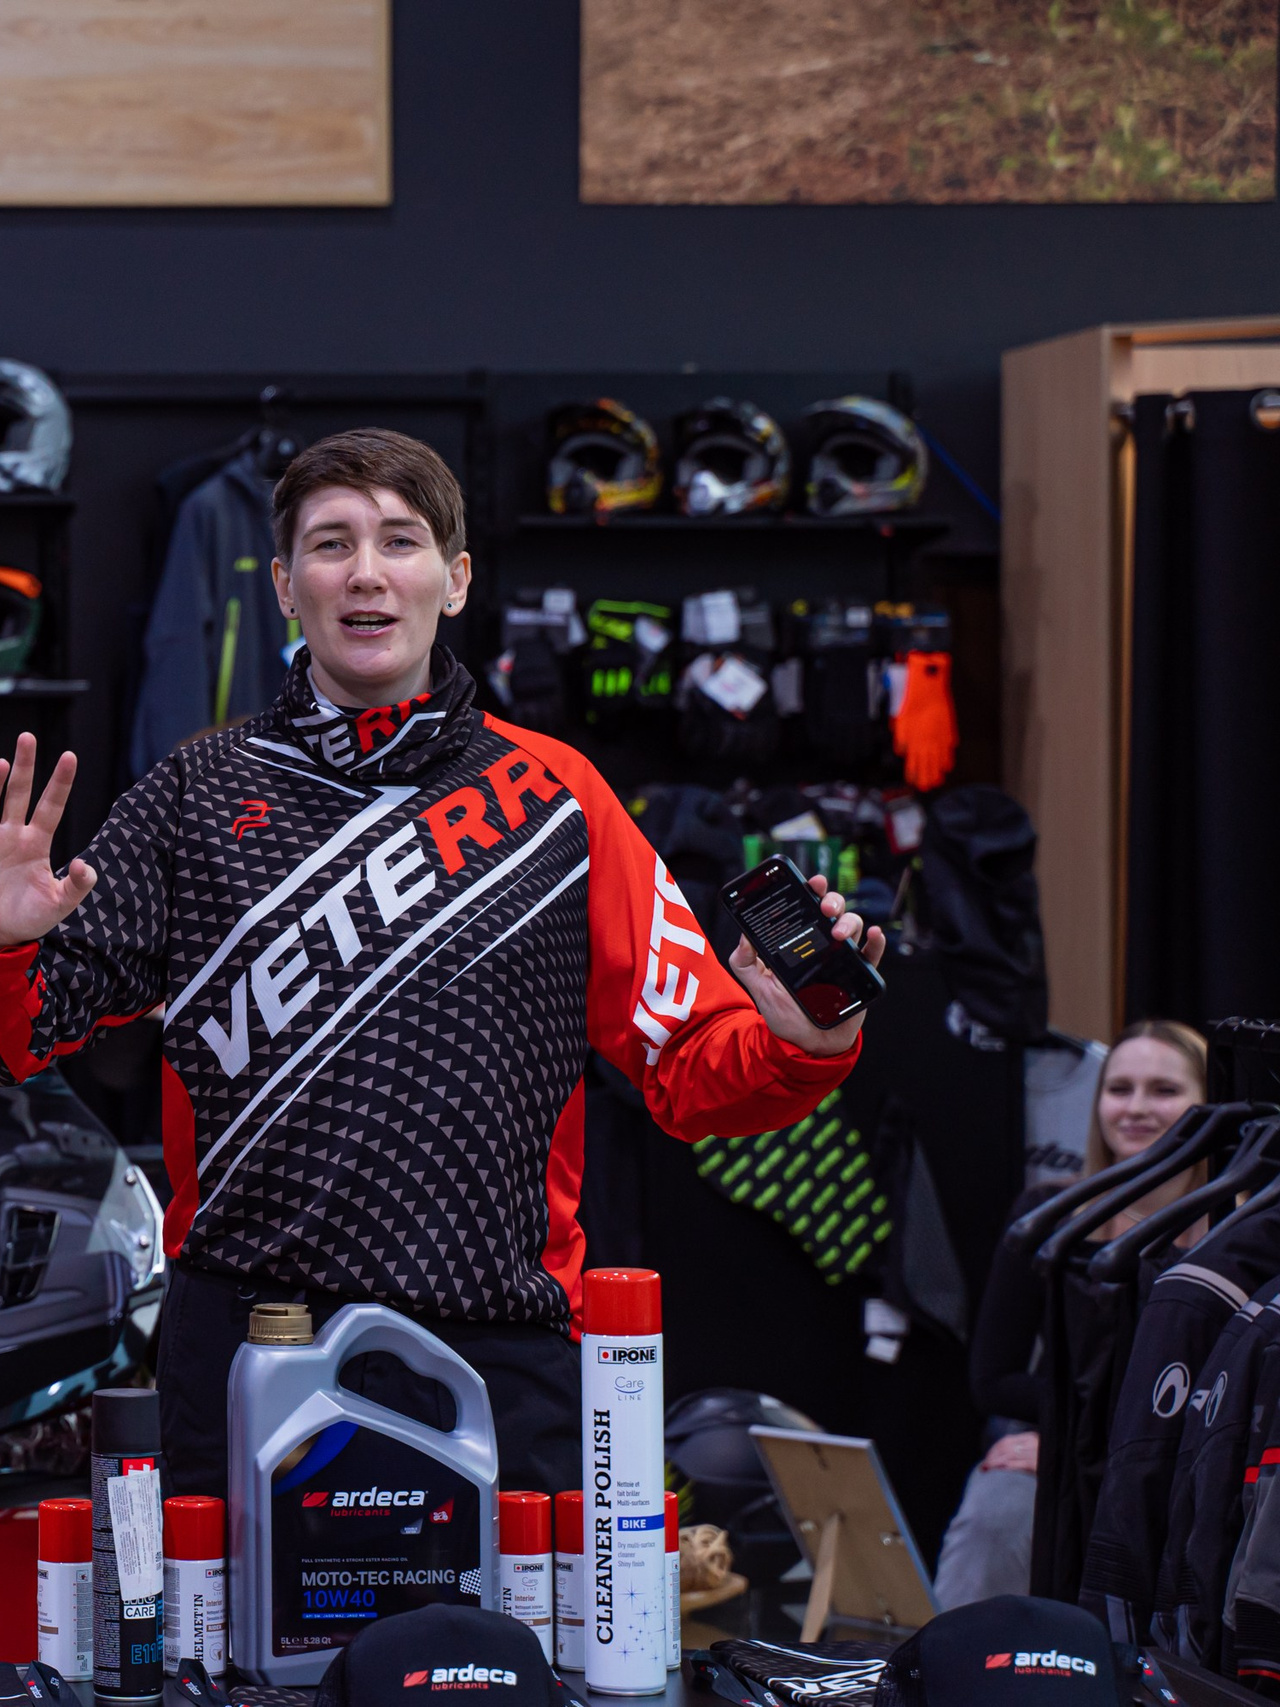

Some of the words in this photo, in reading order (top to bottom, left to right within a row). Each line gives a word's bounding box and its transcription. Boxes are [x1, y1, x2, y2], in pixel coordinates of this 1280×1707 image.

[612, 1349, 656, 1362] IPONE
[614, 1376, 644, 1388] Care
[594, 1408, 612, 1510] POLISH
[332, 1486, 426, 1507] ardeca
[617, 1499, 650, 1507] Multi-surfaces
[622, 1519, 646, 1529] BIKE
[521, 1563, 543, 1571] IPONE
[302, 1570, 389, 1586] MOTO-TEC
[393, 1569, 456, 1585] RACING
[595, 1516, 614, 1645] CLEANER
[303, 1589, 375, 1609] 10W40
[126, 1606, 155, 1618] CARE
[194, 1594, 204, 1661] HELMET'IN
[1014, 1650, 1096, 1676] ardeca
[432, 1663, 517, 1685] ardeca
[431, 1682, 488, 1691] lubricants
